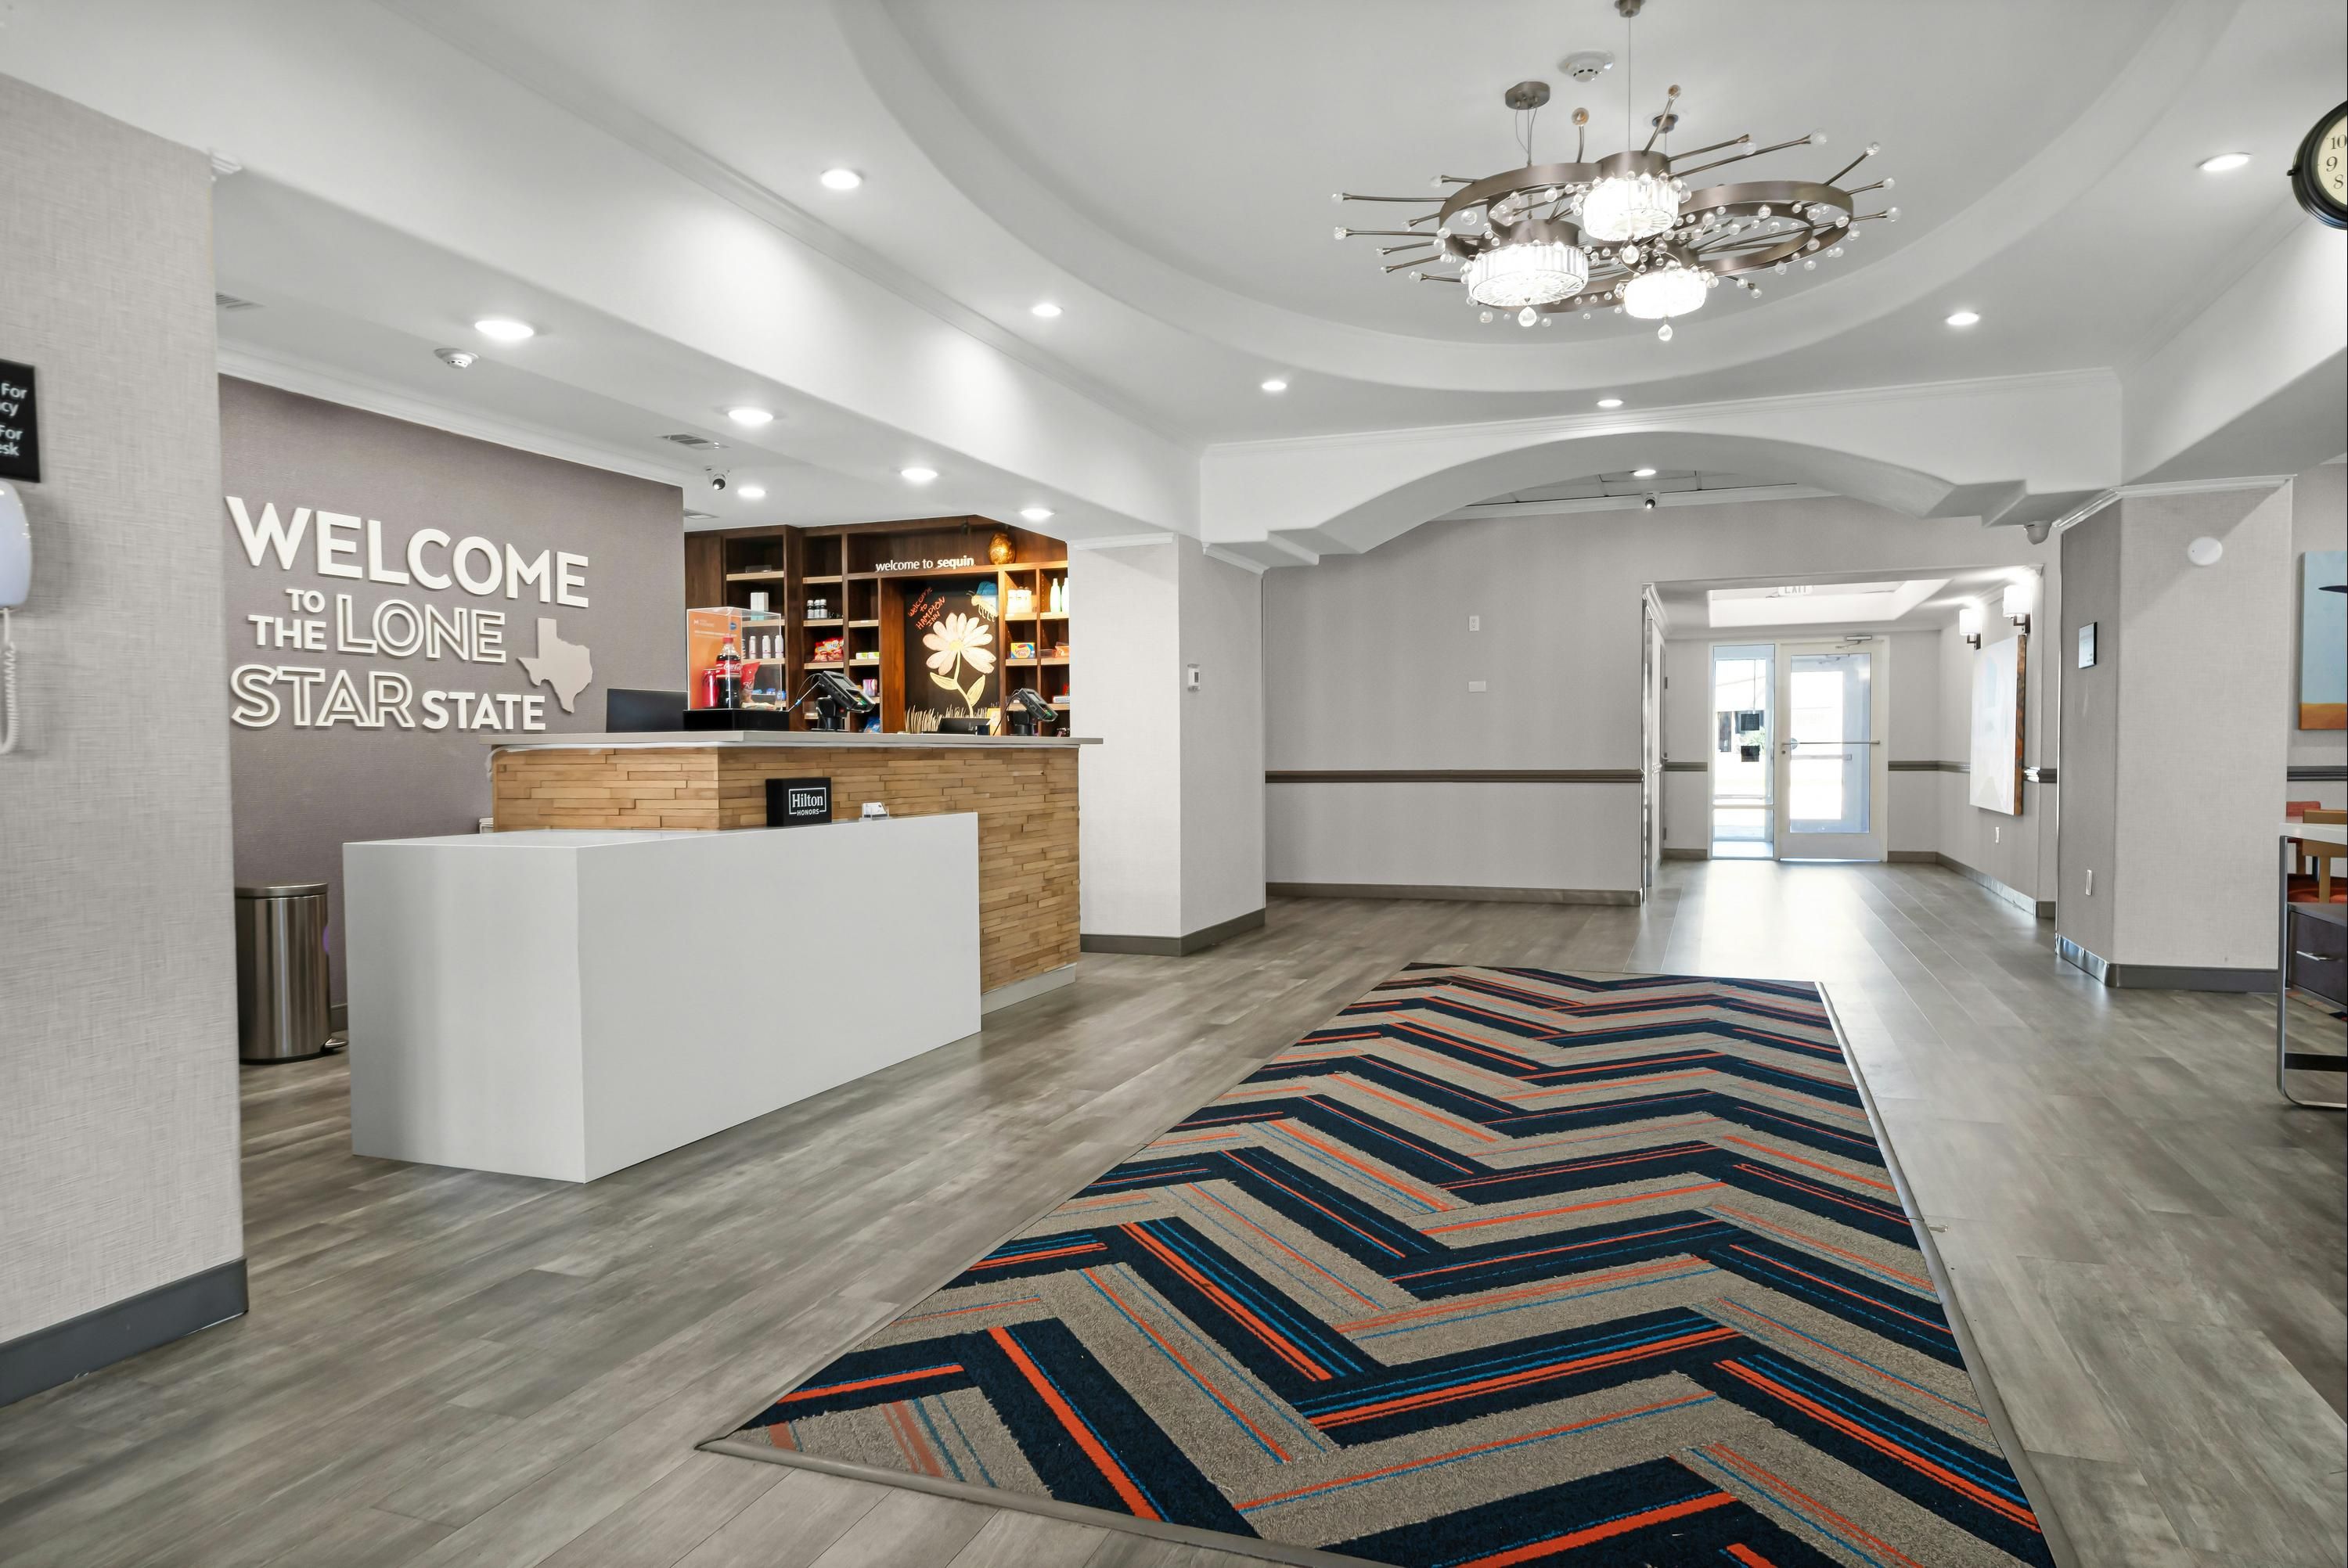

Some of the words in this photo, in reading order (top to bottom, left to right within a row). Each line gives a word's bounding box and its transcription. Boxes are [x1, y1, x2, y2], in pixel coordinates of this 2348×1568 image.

[2331, 135, 2347, 149] 10
[2326, 156, 2338, 172] 9
[2333, 174, 2344, 189] 8
[1, 383, 27, 398] For
[225, 495, 589, 608] WELCOME
[875, 559, 920, 571] welcome
[922, 559, 933, 569] to
[937, 555, 974, 570] sequin
[285, 588, 326, 613] TO
[926, 610, 941, 627] INN
[247, 614, 327, 650] THE
[336, 593, 506, 663] LONE
[230, 664, 416, 728] STAR
[421, 690, 546, 730] STATE
[792, 793, 823, 807] Hilton
